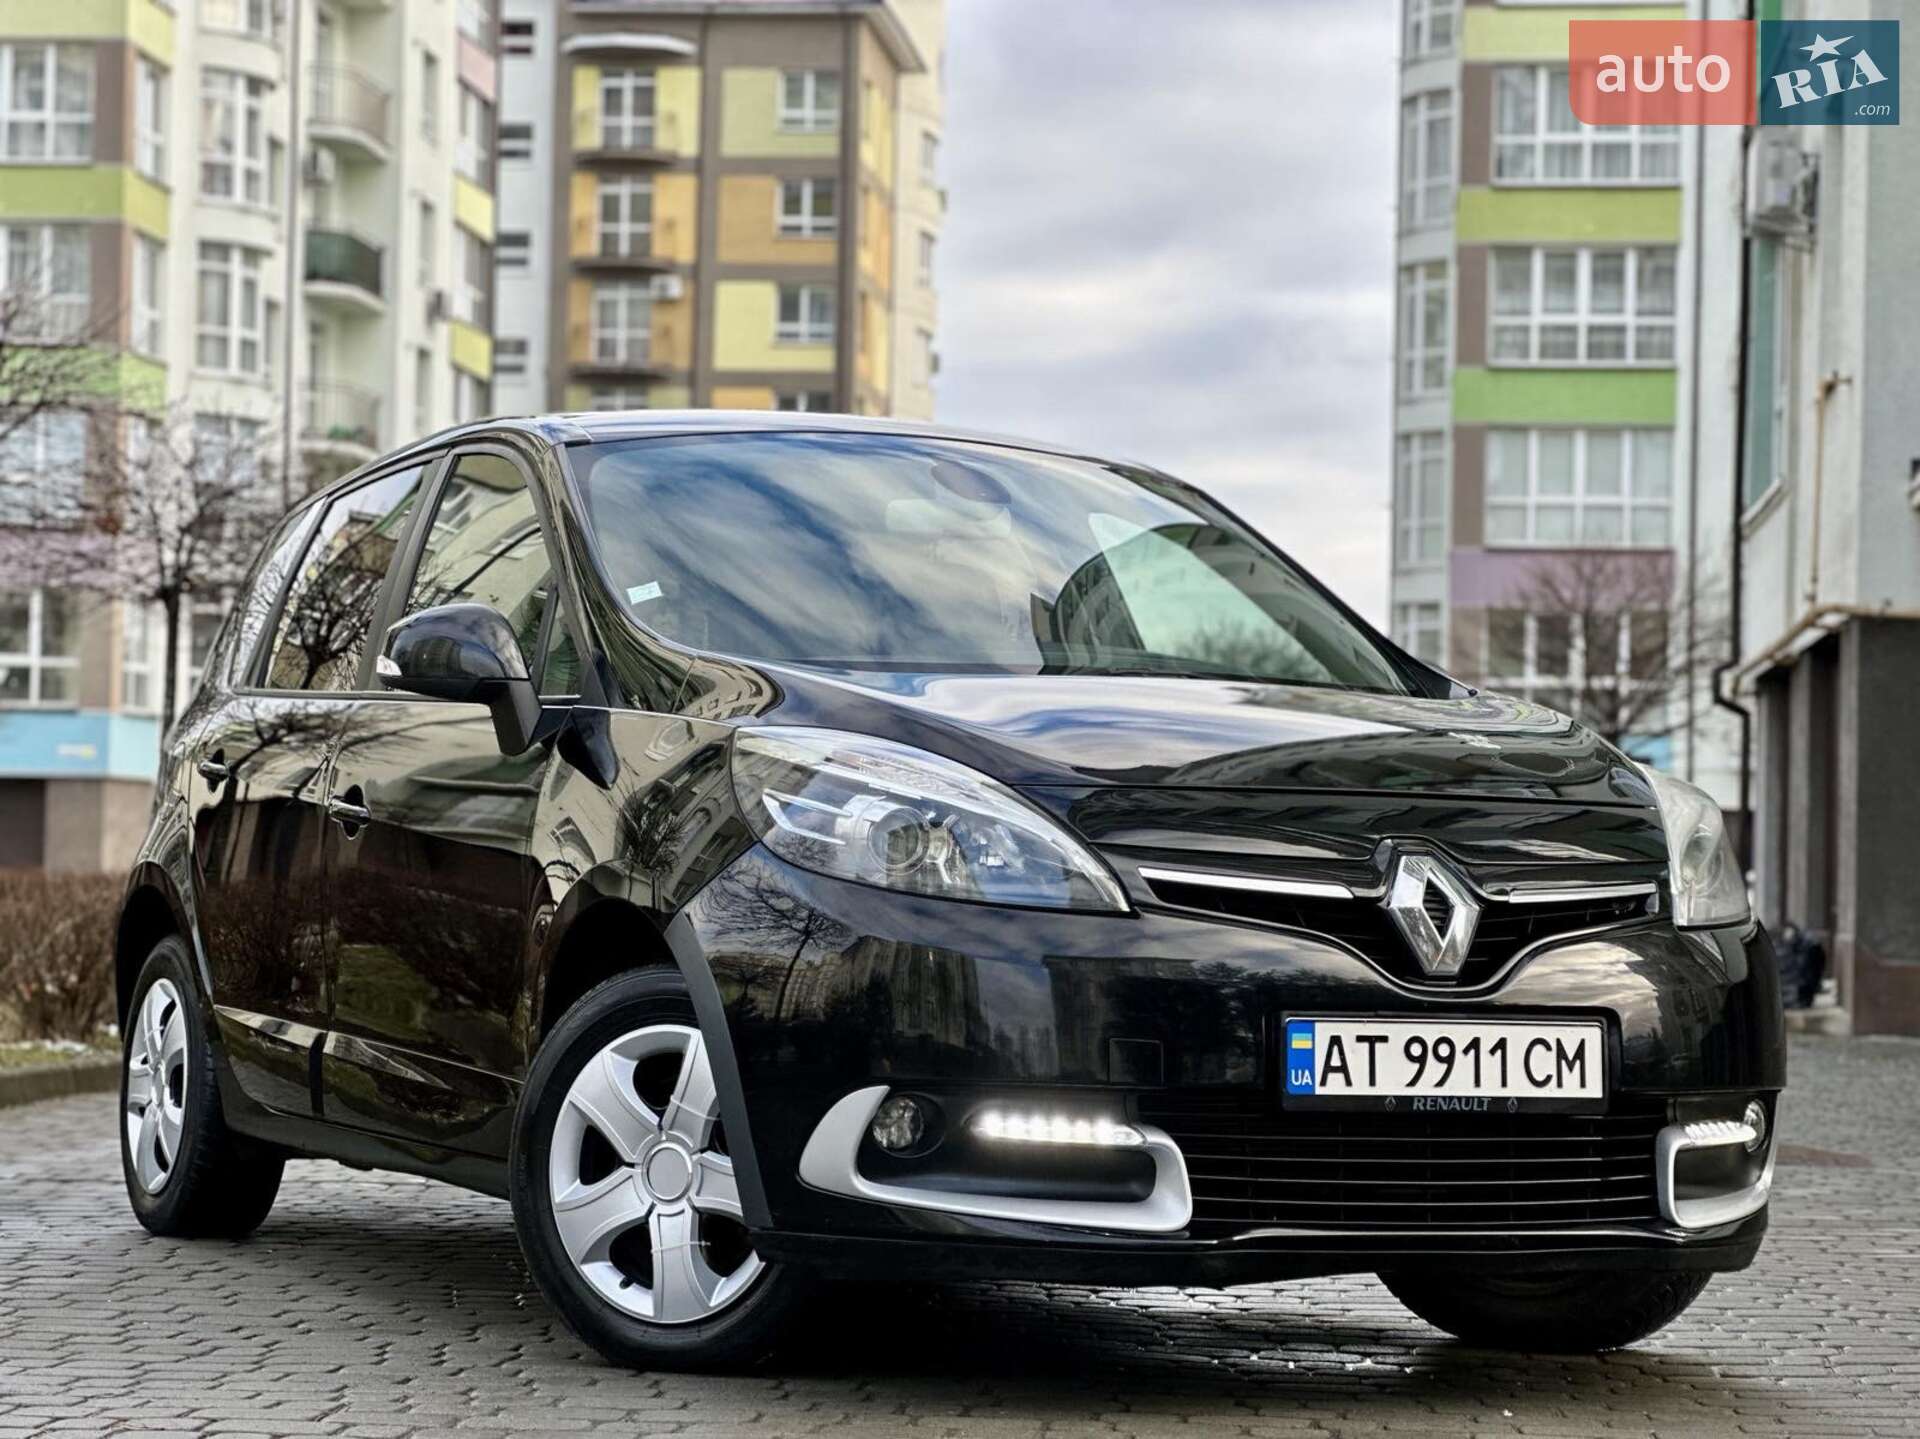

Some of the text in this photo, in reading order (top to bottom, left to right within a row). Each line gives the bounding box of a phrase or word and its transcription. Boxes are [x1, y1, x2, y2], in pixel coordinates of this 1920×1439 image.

[1319, 1035, 1586, 1089] AT 9911 CM
[1291, 1069, 1312, 1086] UA
[1412, 1096, 1492, 1112] RENAULT
